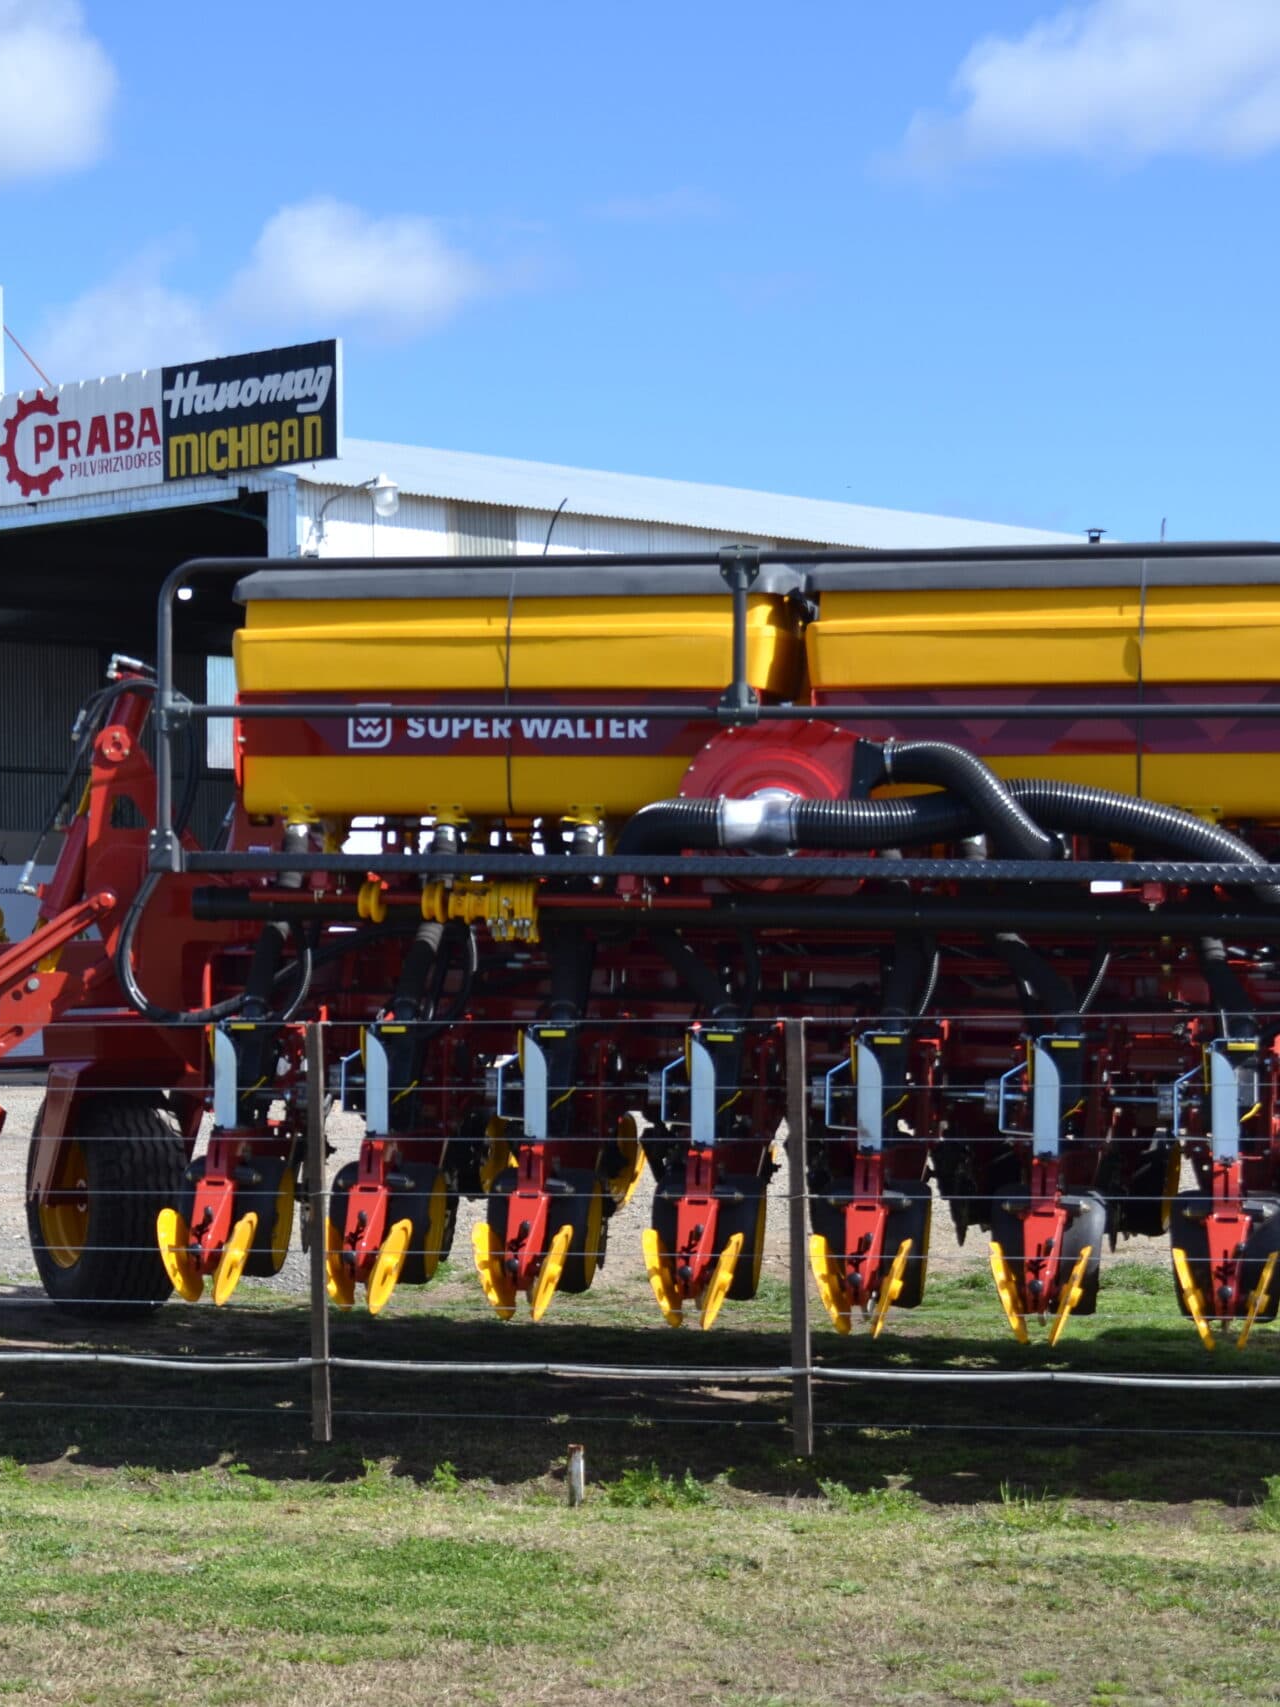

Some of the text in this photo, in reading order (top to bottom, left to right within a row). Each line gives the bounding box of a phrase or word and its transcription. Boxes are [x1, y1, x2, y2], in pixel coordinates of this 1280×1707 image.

[34, 407, 161, 465] PRABA
[169, 415, 322, 478] MICHIGAN
[406, 717, 512, 739] SUPER
